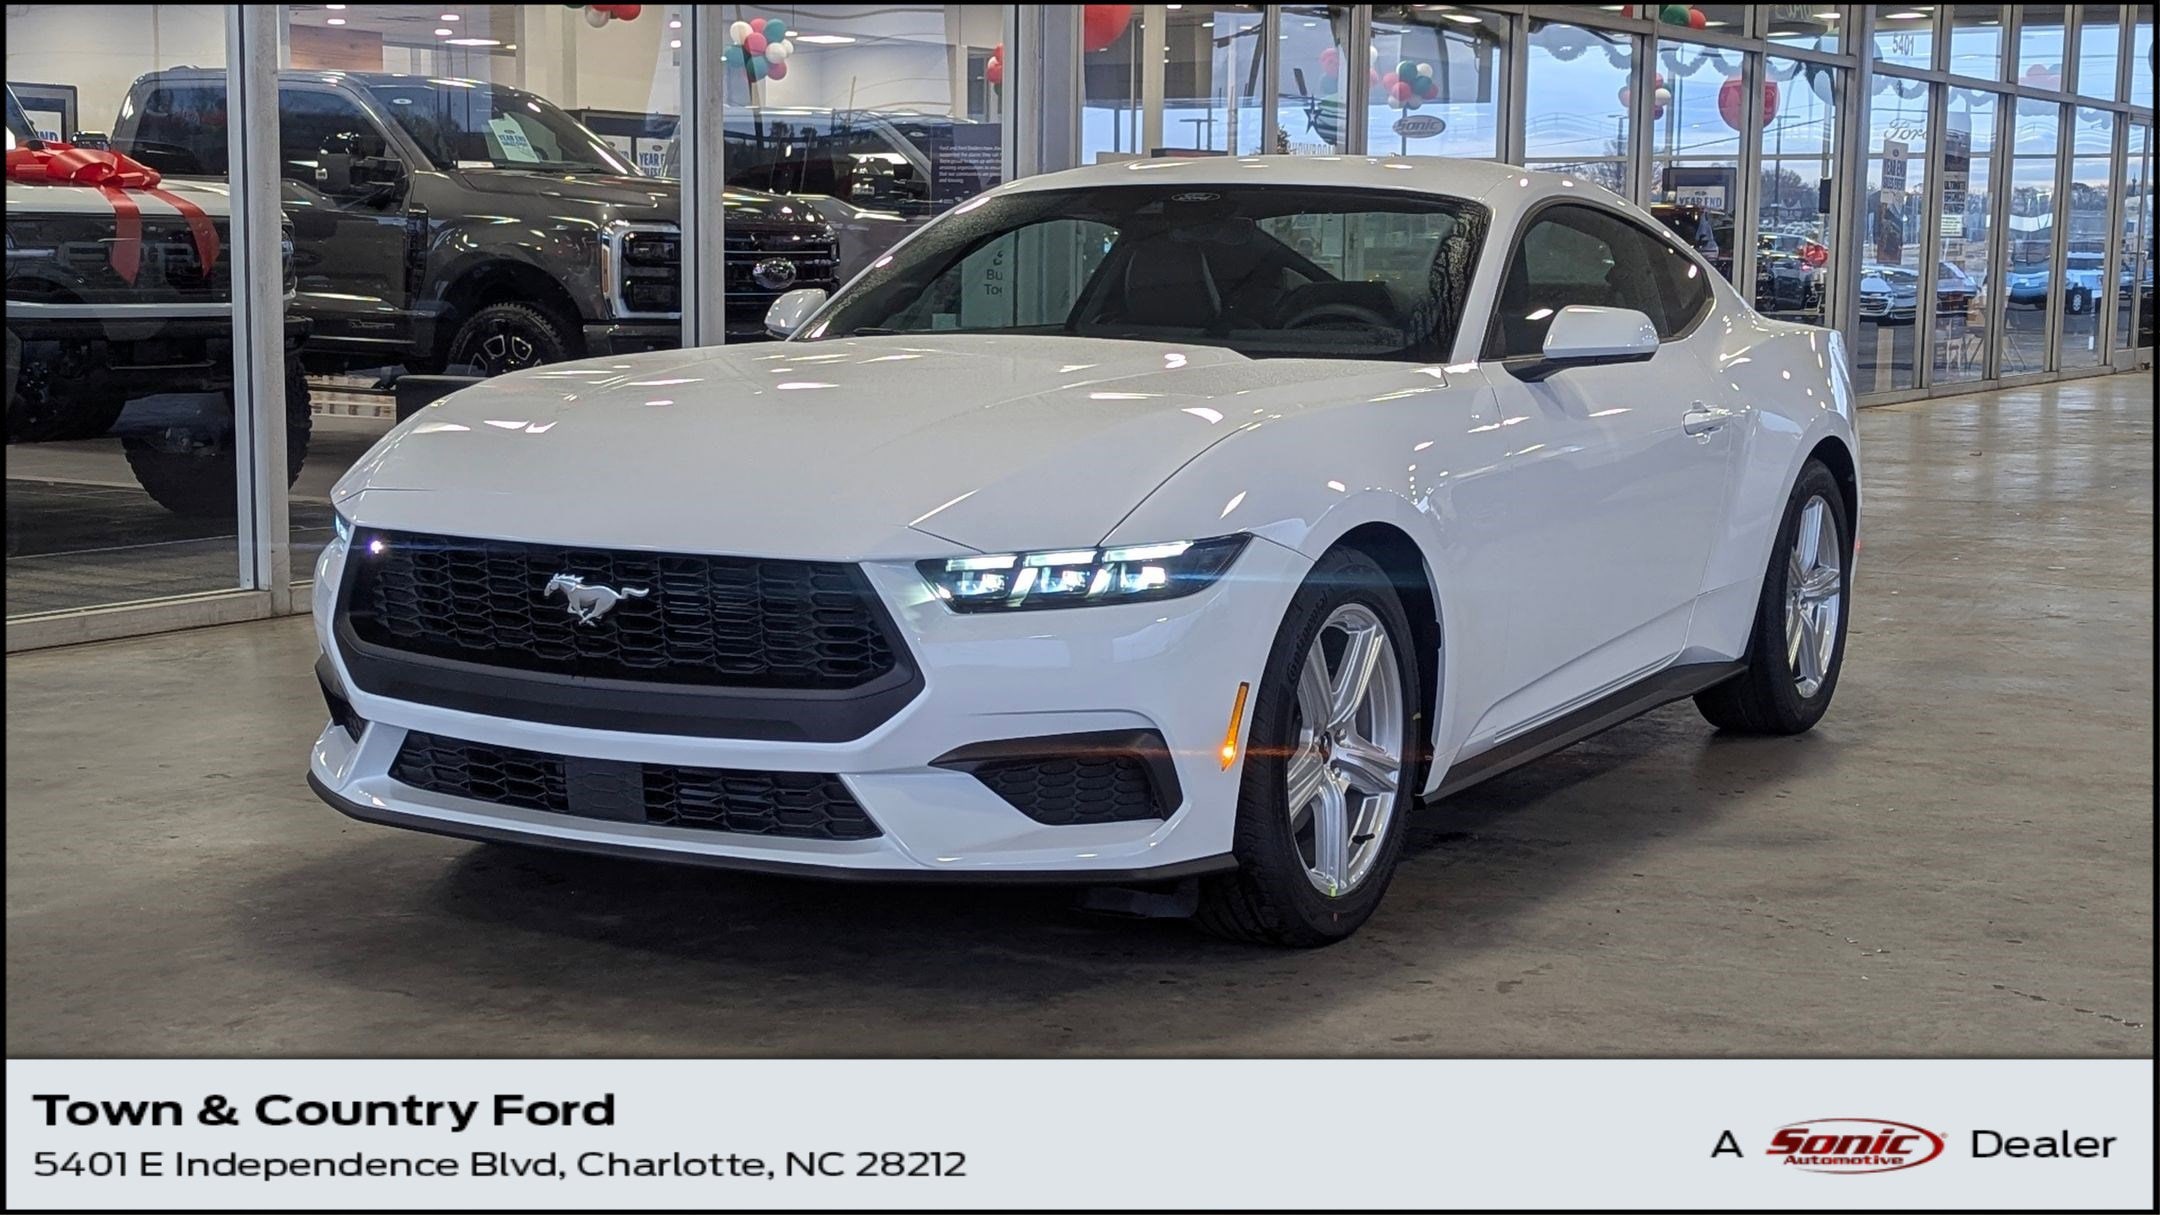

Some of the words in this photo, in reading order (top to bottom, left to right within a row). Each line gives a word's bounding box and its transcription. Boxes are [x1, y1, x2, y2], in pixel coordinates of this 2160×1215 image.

[1892, 32, 1914, 56] 5401
[639, 152, 660, 167] YEAR
[1678, 196, 1703, 206] YEAR
[1704, 196, 1723, 208] END
